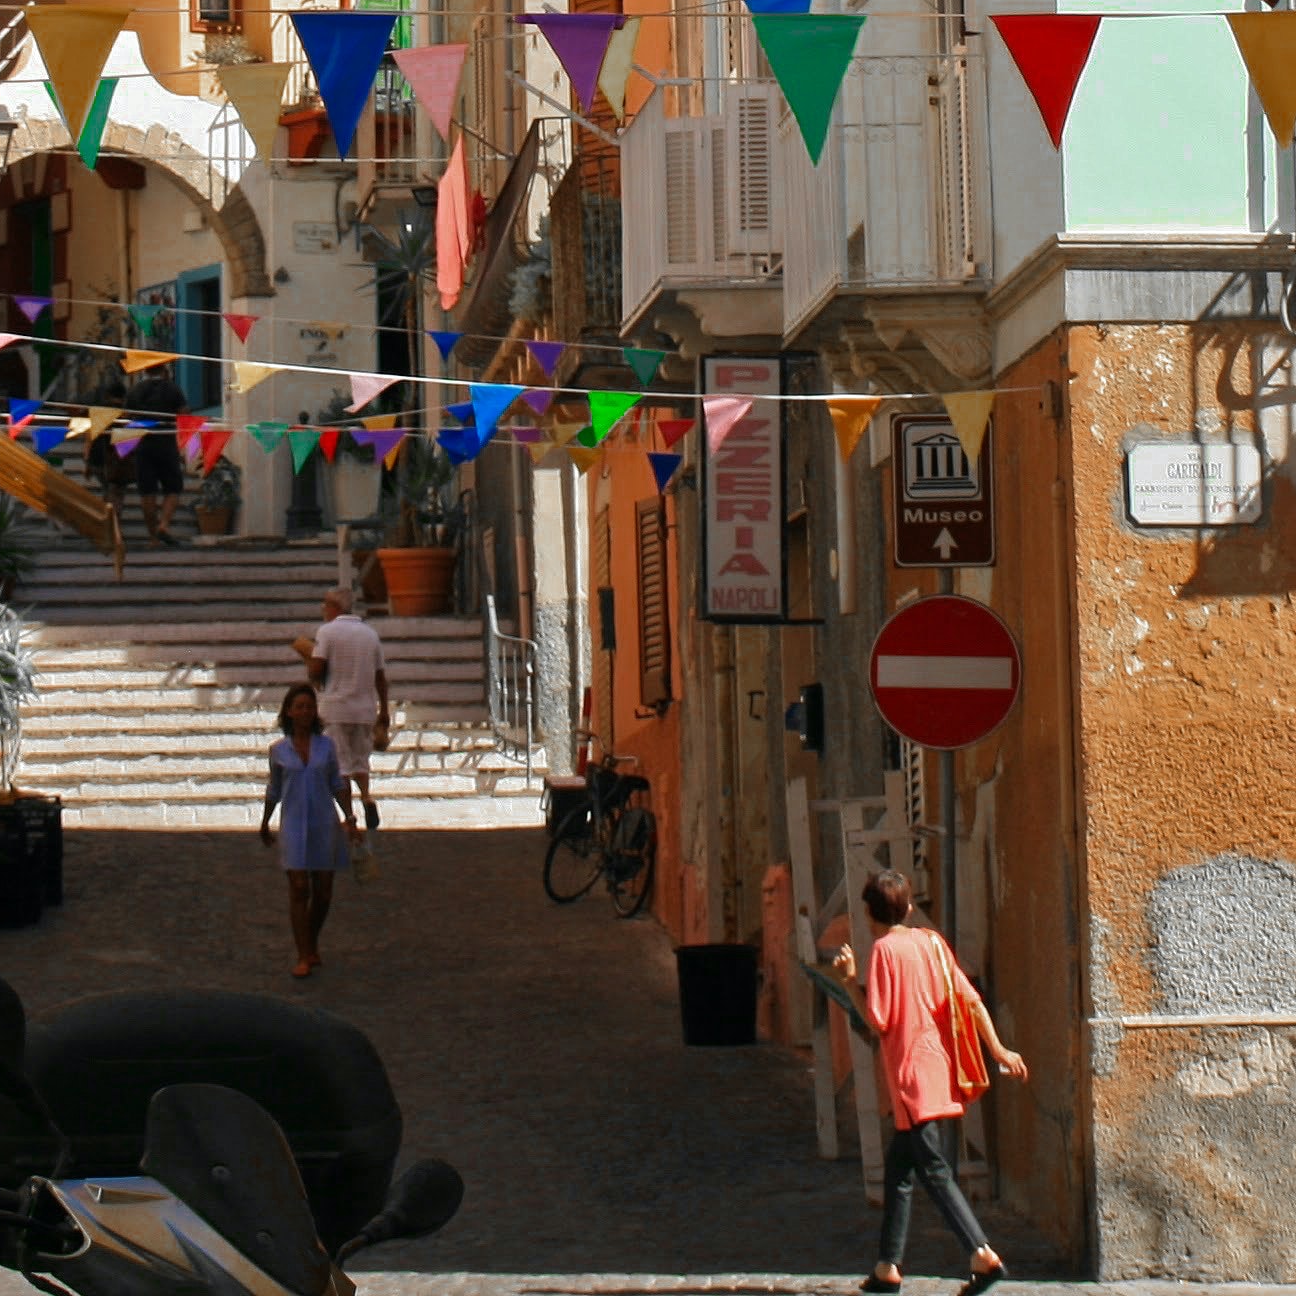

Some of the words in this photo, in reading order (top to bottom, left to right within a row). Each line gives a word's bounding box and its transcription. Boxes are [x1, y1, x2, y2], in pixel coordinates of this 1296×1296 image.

[715, 365, 772, 576] PZZERIA
[1167, 463, 1223, 479] GARIBALDI
[904, 508, 983, 523] Museo
[712, 587, 778, 610] NAPOLI
